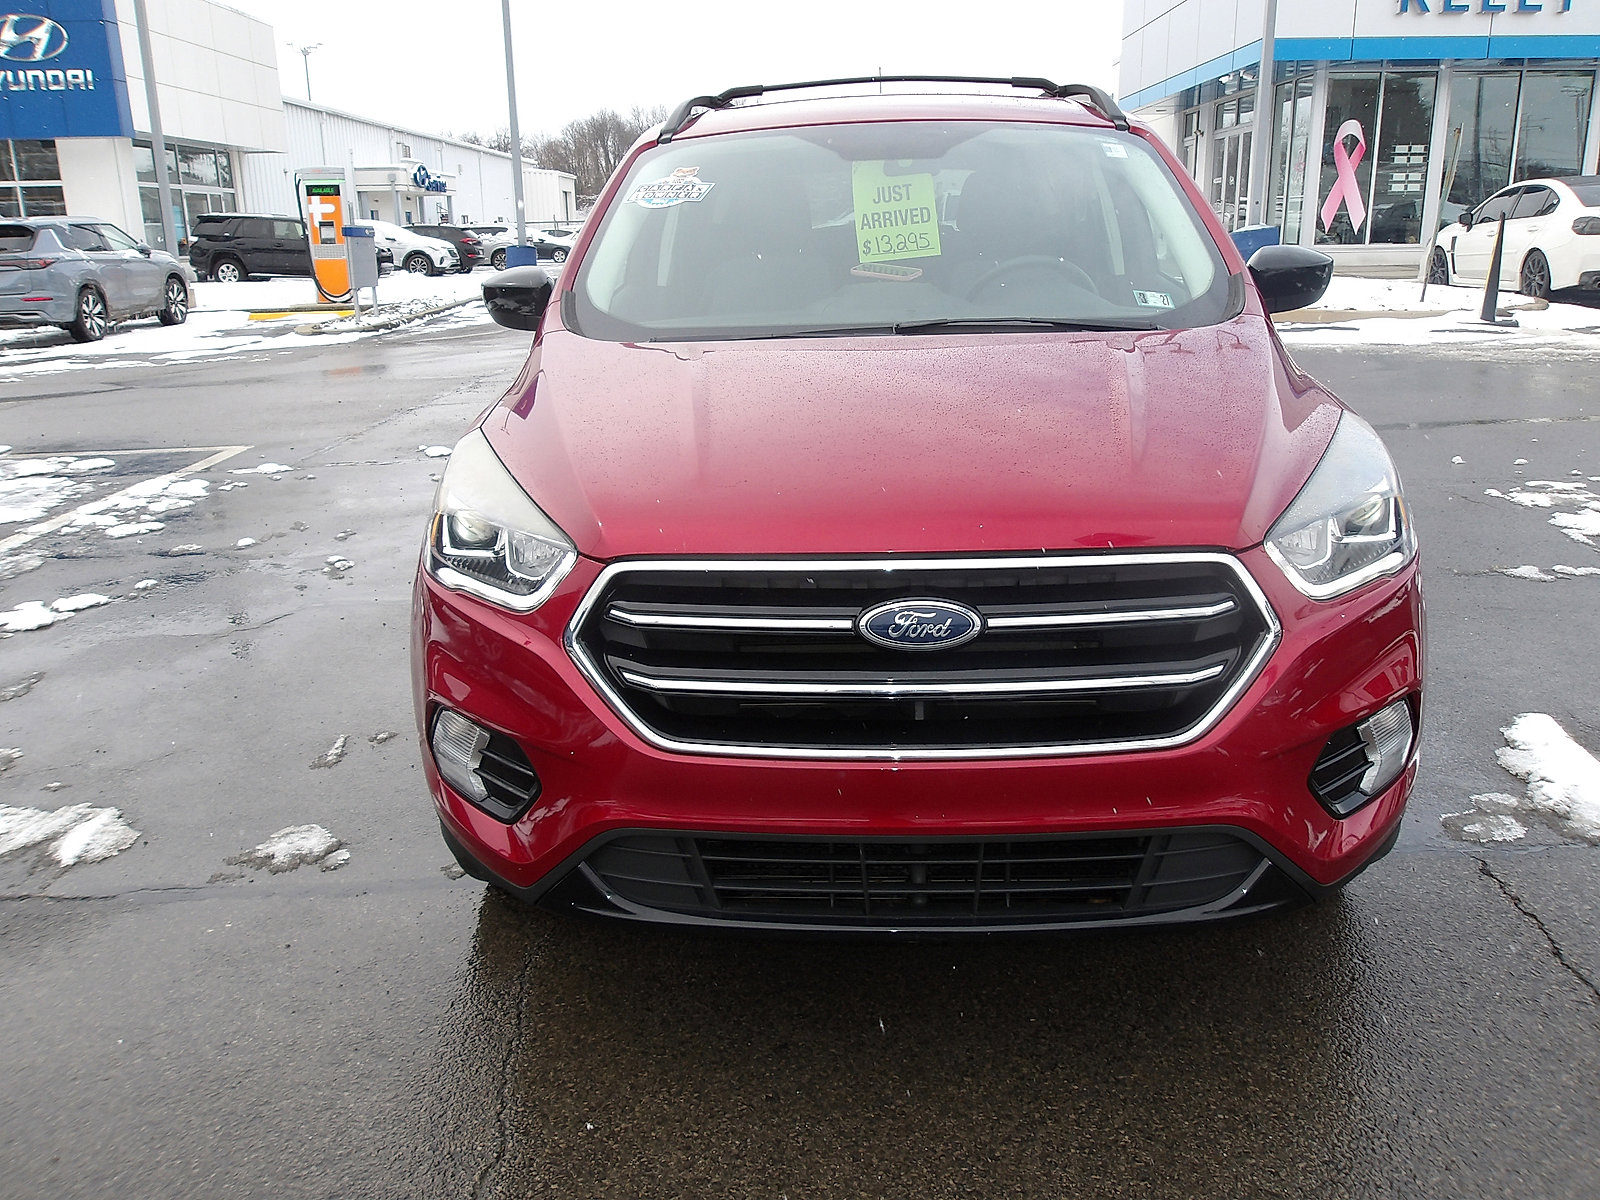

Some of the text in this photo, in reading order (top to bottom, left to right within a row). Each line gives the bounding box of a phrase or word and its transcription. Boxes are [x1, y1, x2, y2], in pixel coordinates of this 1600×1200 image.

[873, 183, 912, 204] JUST
[860, 206, 931, 230] ARRIVED
[888, 610, 953, 638] Ford
